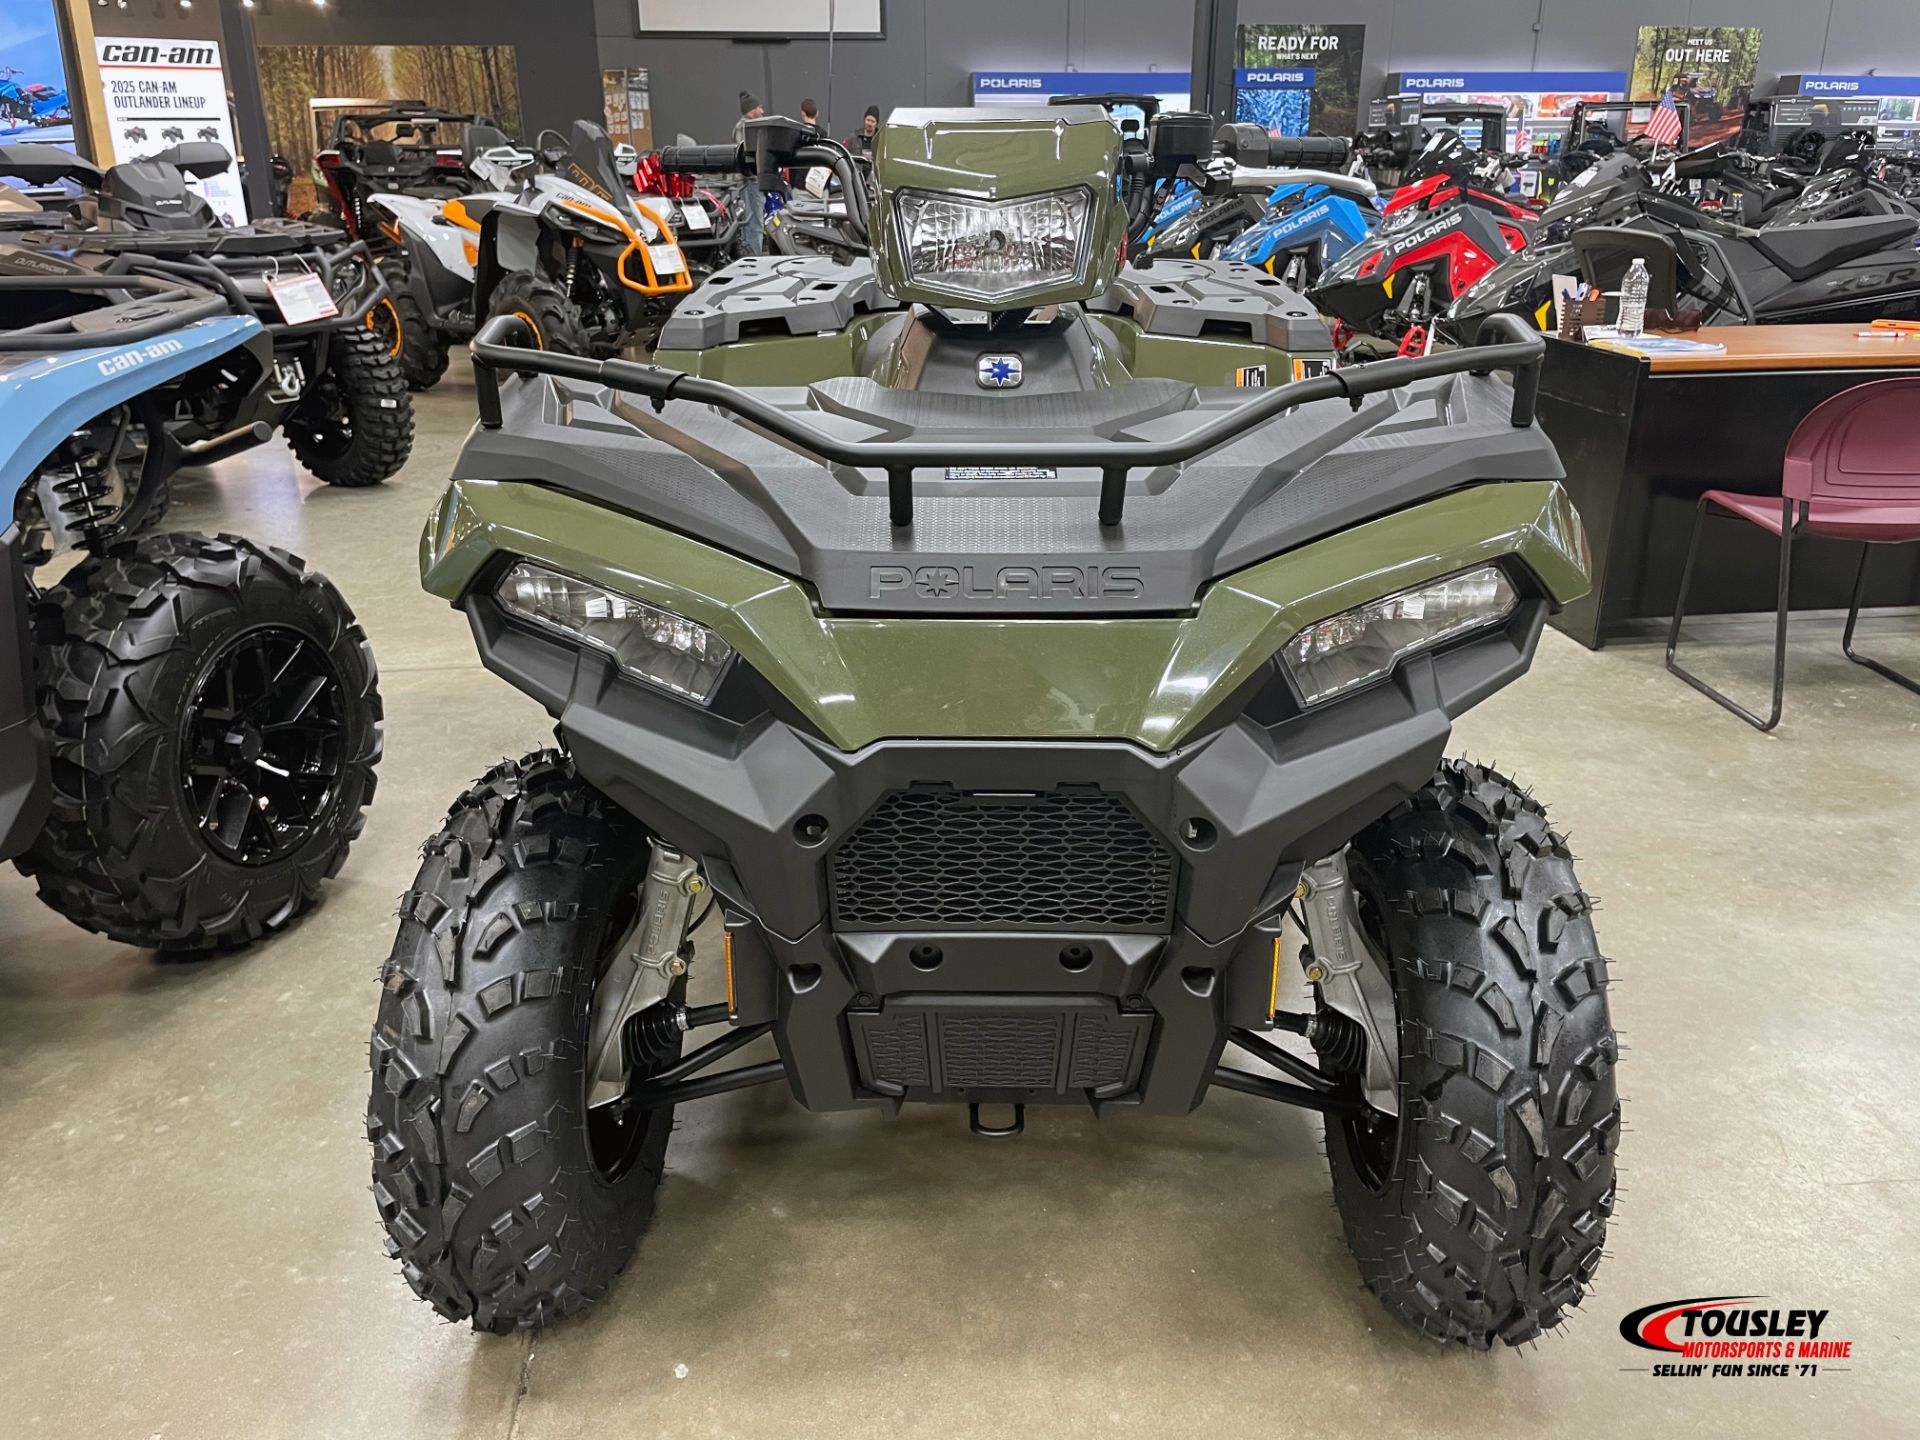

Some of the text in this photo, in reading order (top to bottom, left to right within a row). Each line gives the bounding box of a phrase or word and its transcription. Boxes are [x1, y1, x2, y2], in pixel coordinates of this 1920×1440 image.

[1257, 36, 1339, 51] READY FOR
[1687, 38, 1713, 46] MEET US
[102, 44, 214, 65] can-am
[1275, 52, 1319, 60] WHAT'S NEXT
[1665, 49, 1731, 63] OUT HERE
[980, 78, 1042, 88] POLARIS
[1247, 73, 1304, 82] POLARIS
[1405, 78, 1465, 88] POLARIS
[110, 80, 178, 94] 2025 CAN-AM
[1805, 81, 1859, 91] POLARIS
[113, 95, 206, 109] OUTLANDER LINEUP
[1273, 204, 1329, 239] POLARIS
[1393, 212, 1462, 254] POLARIS
[14, 257, 69, 275] OUTLANDER
[97, 338, 183, 377] can-am
[868, 565, 1145, 599] POLARIS
